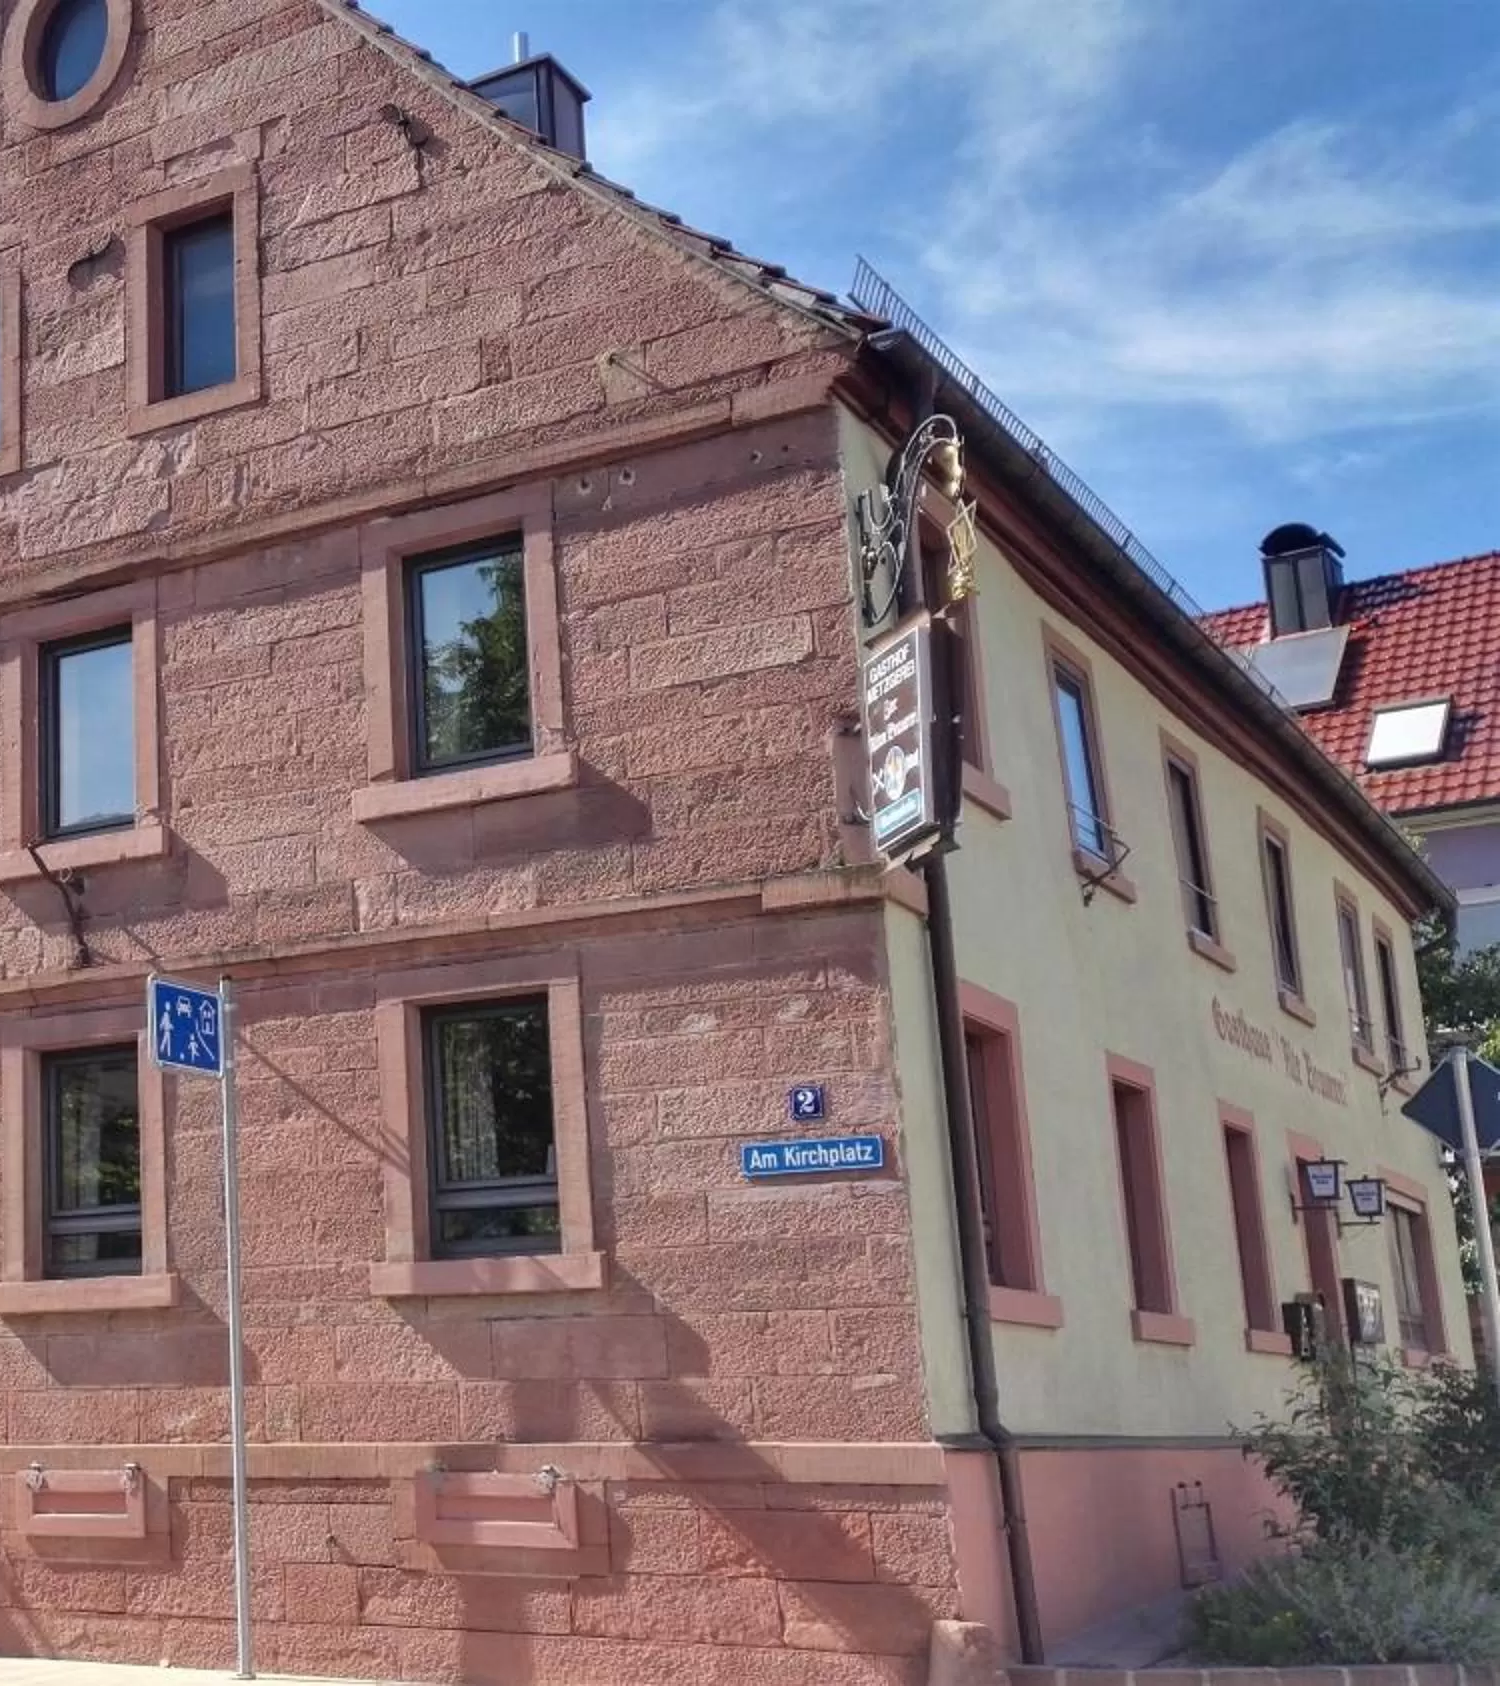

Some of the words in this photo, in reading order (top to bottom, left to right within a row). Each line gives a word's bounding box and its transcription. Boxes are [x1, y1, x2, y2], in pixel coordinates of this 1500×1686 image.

[869, 643, 910, 685] GASTHOF
[797, 1090, 815, 1113] 2
[750, 1150, 777, 1169] Am
[785, 1142, 874, 1167] Kirchplatz
